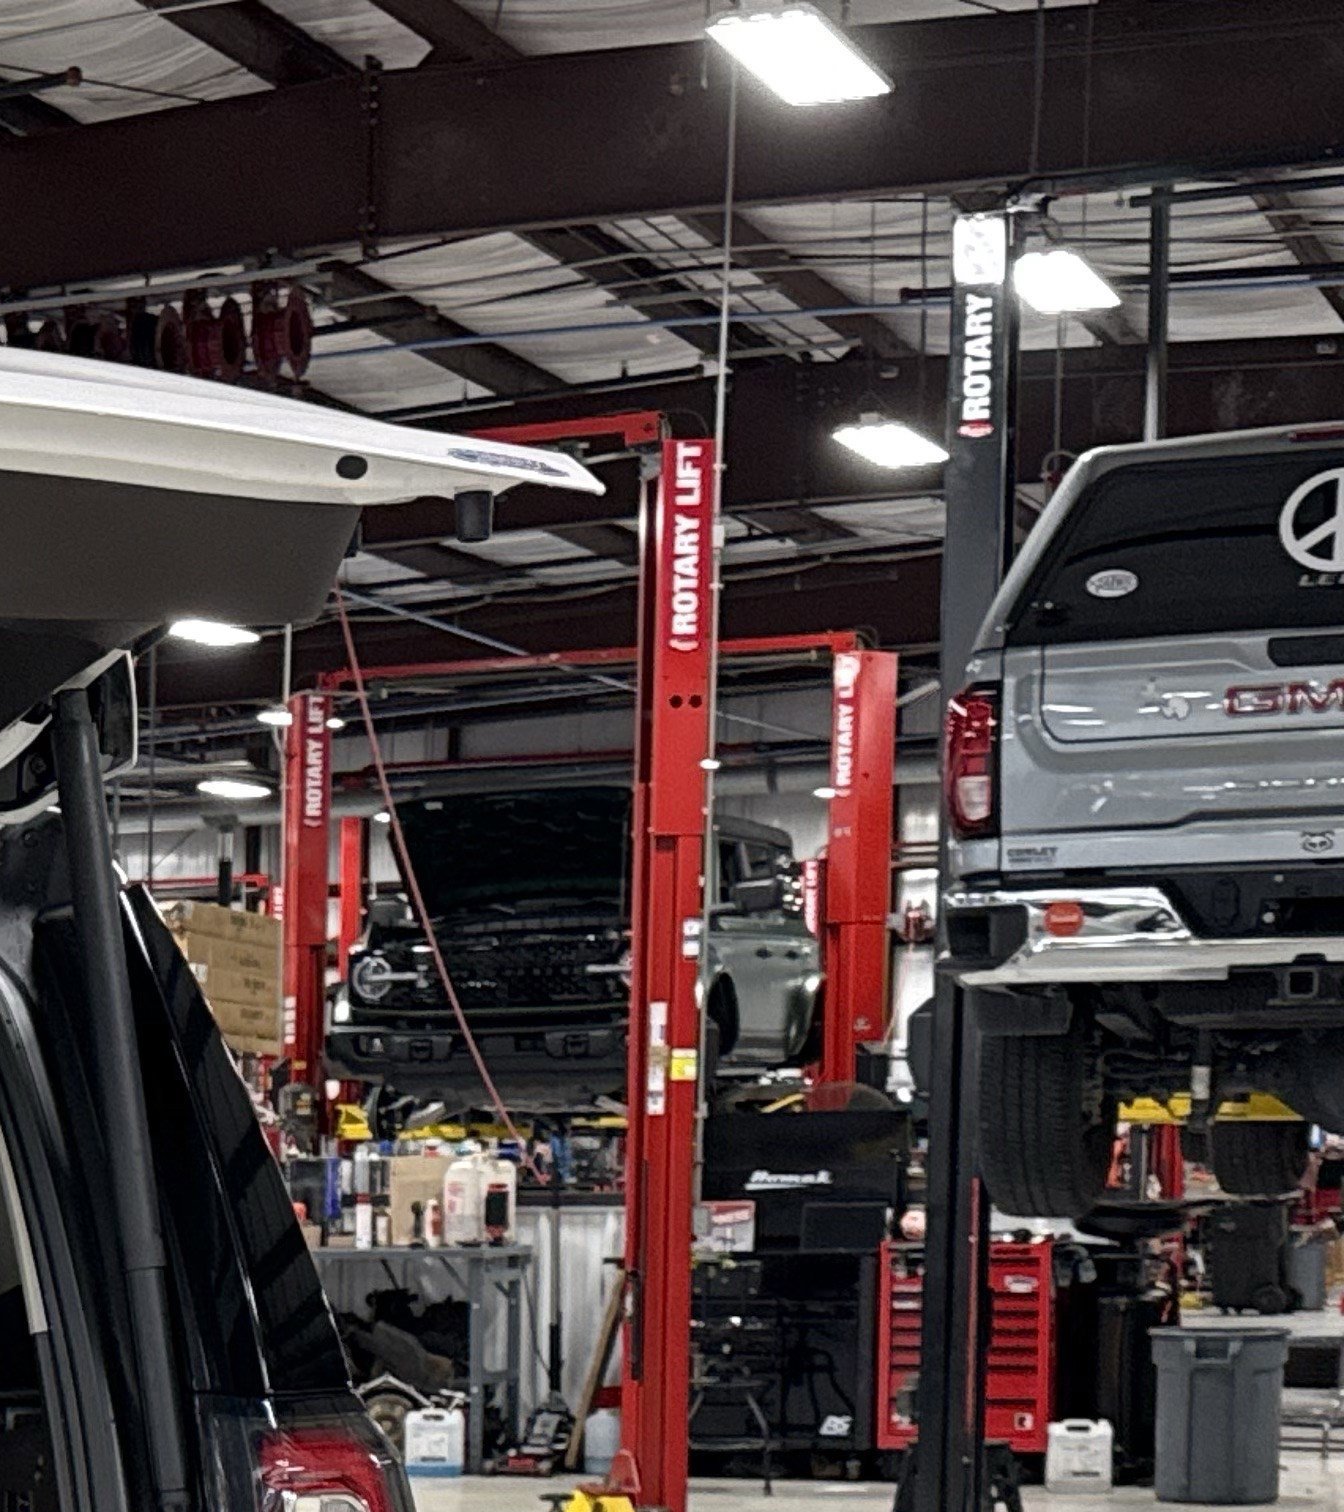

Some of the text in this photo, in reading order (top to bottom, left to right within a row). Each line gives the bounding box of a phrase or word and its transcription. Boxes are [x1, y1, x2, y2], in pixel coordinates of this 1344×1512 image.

[962, 293, 993, 420] ROTARY
[671, 441, 703, 635] ROTARY LIFT
[305, 694, 325, 817] ROTARY LIFT
[836, 703, 854, 788] ROTARY
